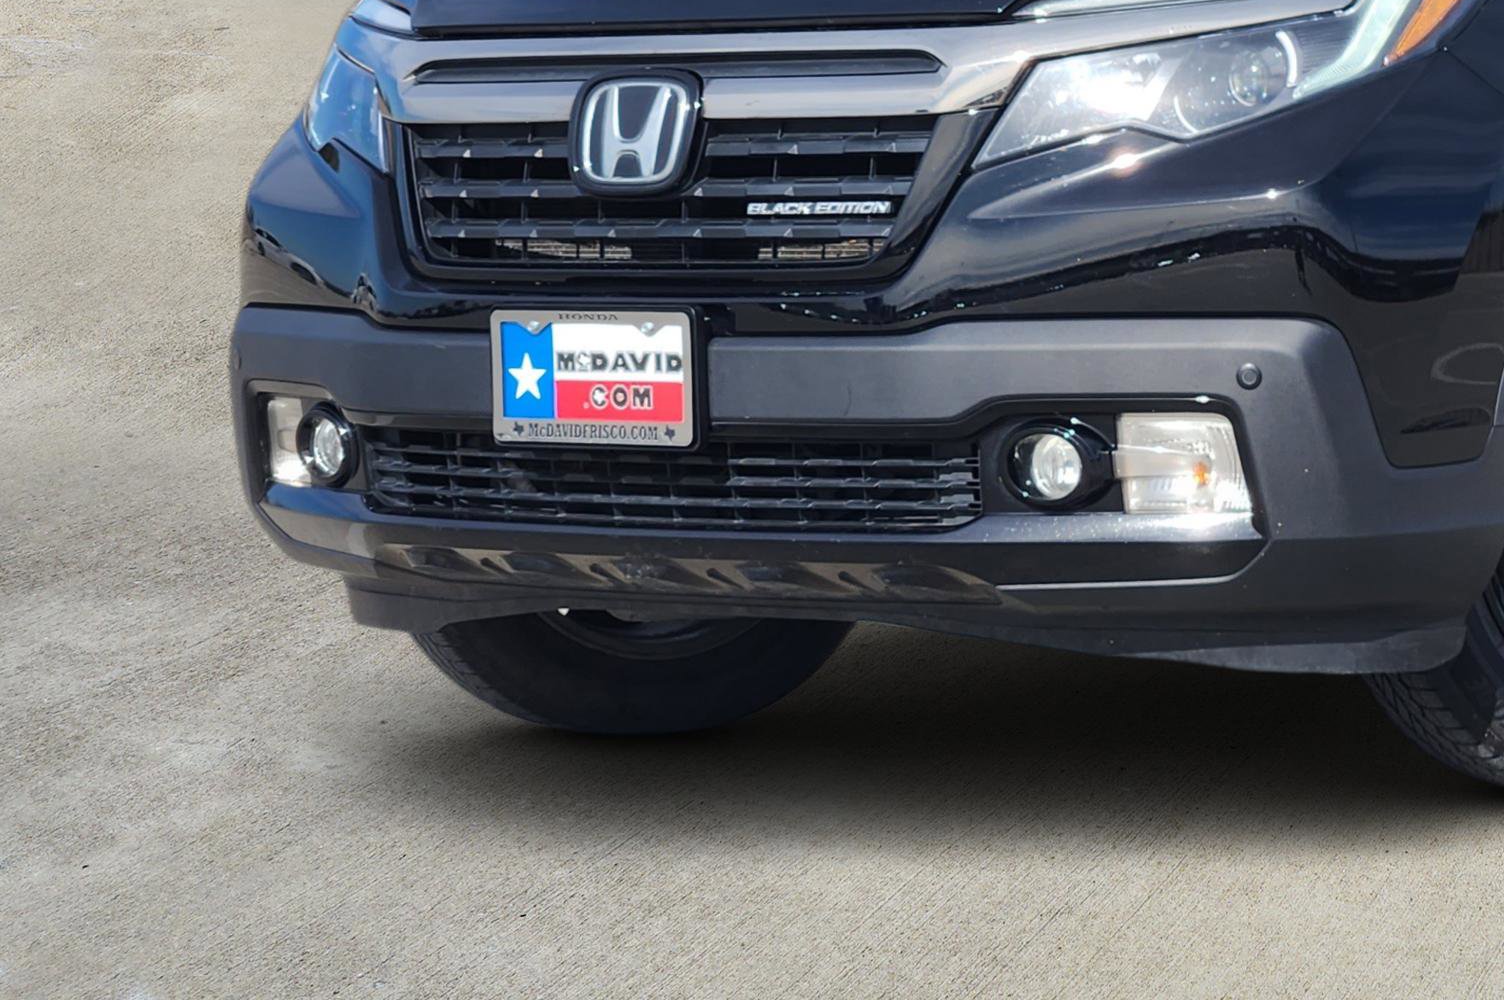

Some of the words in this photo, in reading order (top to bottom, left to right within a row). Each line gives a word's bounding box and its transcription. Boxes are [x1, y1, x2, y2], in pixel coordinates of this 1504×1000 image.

[747, 202, 814, 215] BLACK
[814, 201, 891, 214] EDITION
[558, 313, 619, 321] HONDA
[557, 352, 682, 372] McDAVID
[528, 423, 659, 441] McDAVIDFRISCO.COM
